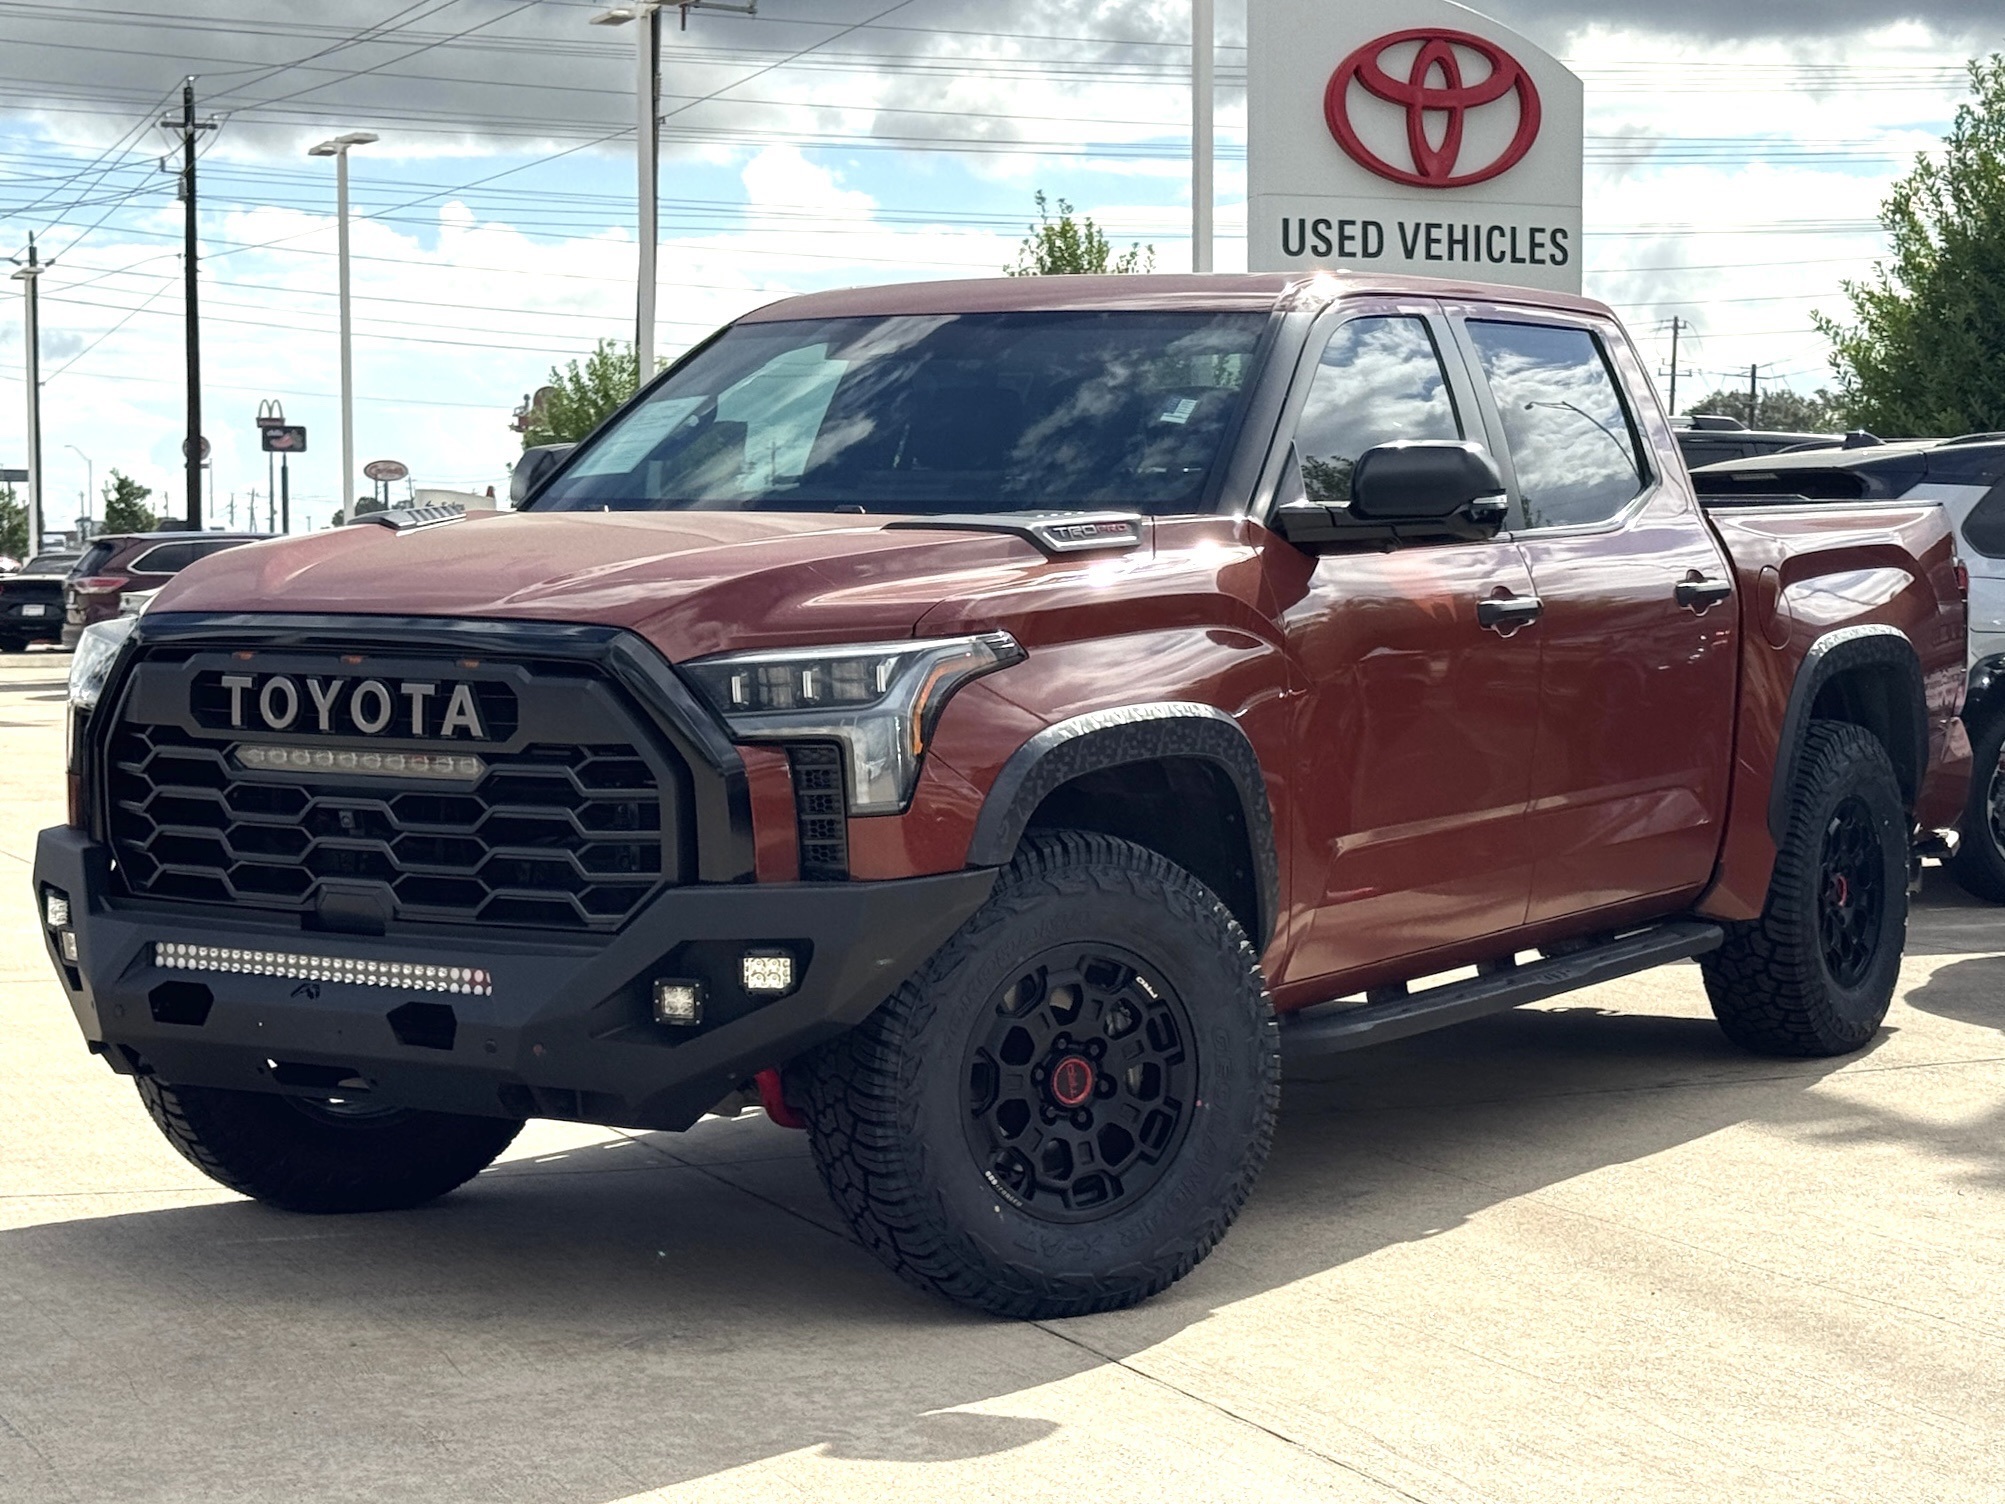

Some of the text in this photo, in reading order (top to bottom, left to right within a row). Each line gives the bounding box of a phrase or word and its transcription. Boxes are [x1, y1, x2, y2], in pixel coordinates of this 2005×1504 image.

[1281, 217, 1570, 267] USED VEHICLES
[1053, 523, 1097, 540] TRD
[221, 675, 485, 738] TOYOTA
